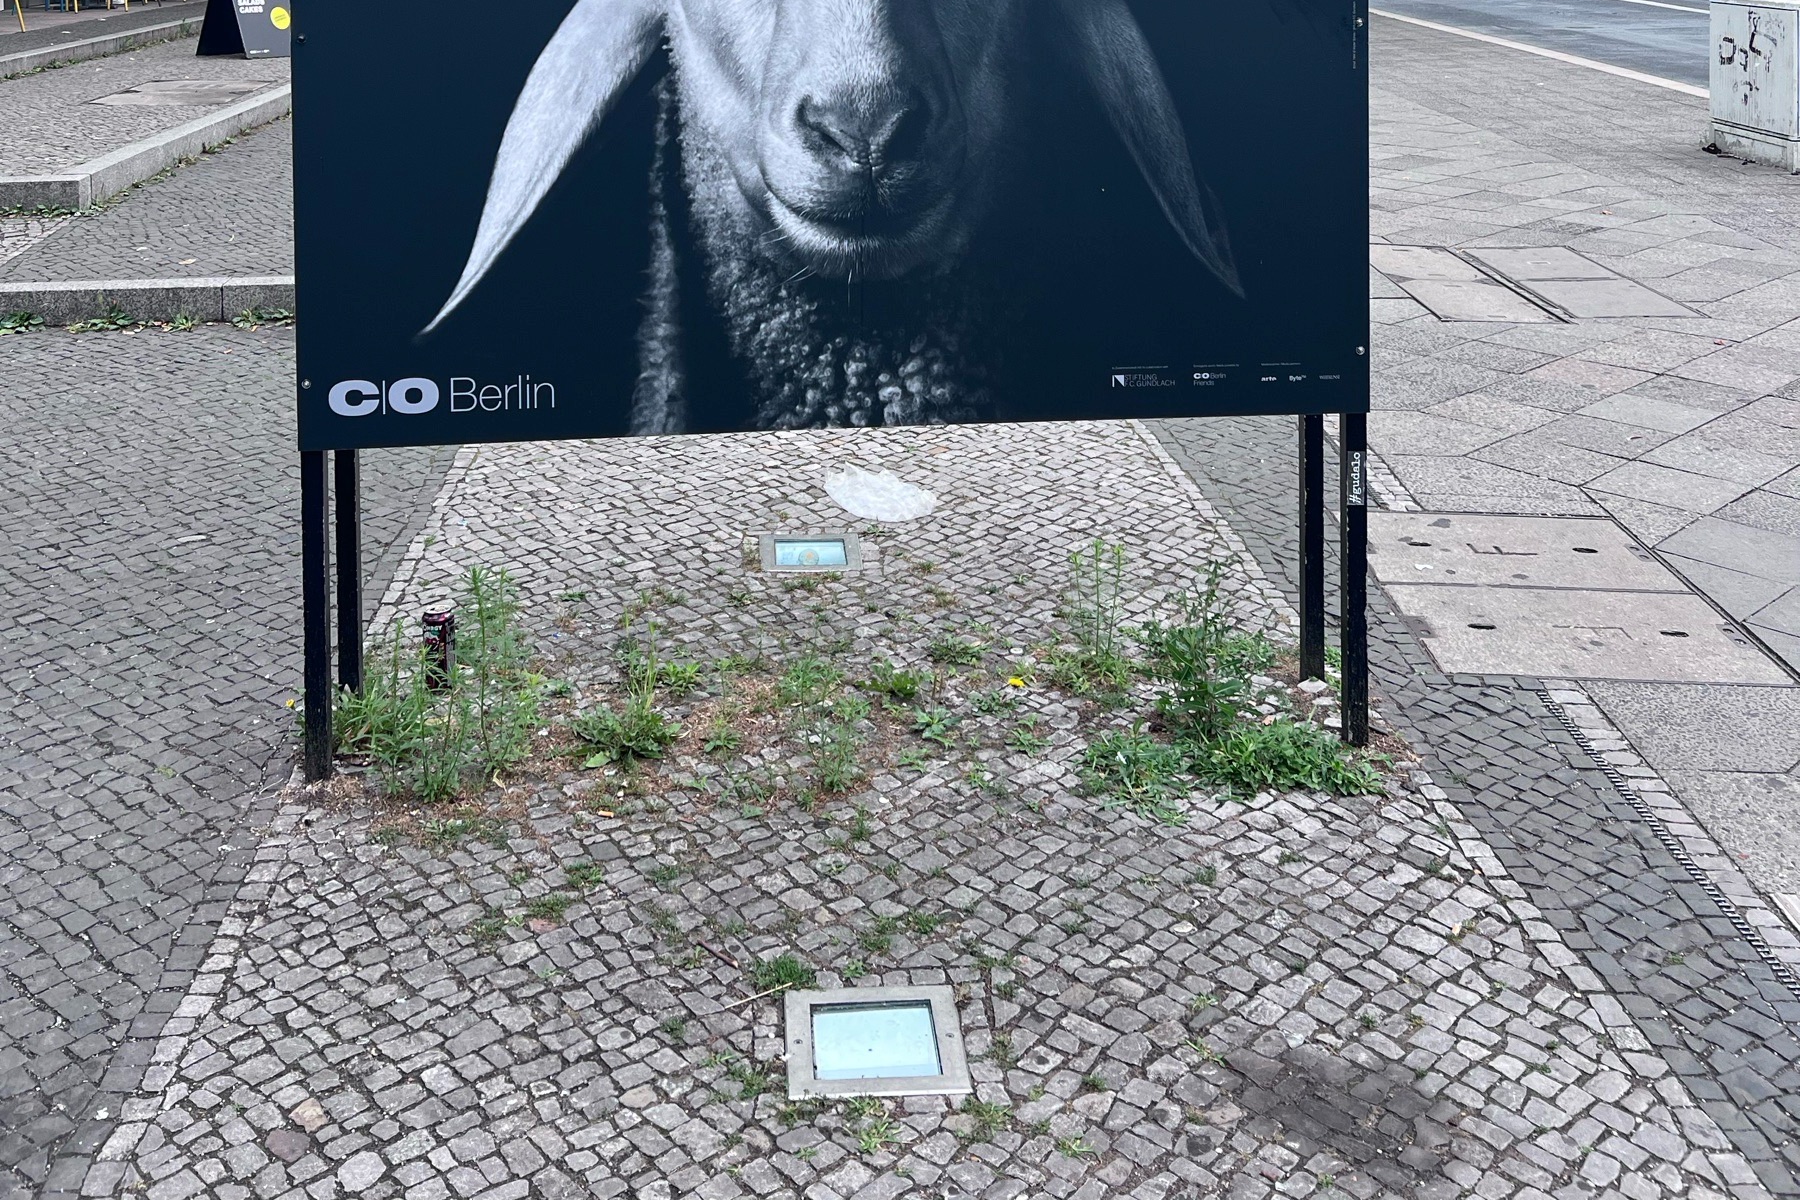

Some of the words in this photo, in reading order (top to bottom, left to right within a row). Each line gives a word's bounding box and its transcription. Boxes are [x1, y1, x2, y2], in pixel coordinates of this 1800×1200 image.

[239, 6, 263, 14] CAKES
[1124, 373, 1158, 381] STIFTUNG
[1136, 379, 1176, 388] GUNDLACH
[450, 374, 555, 413] Berlin
